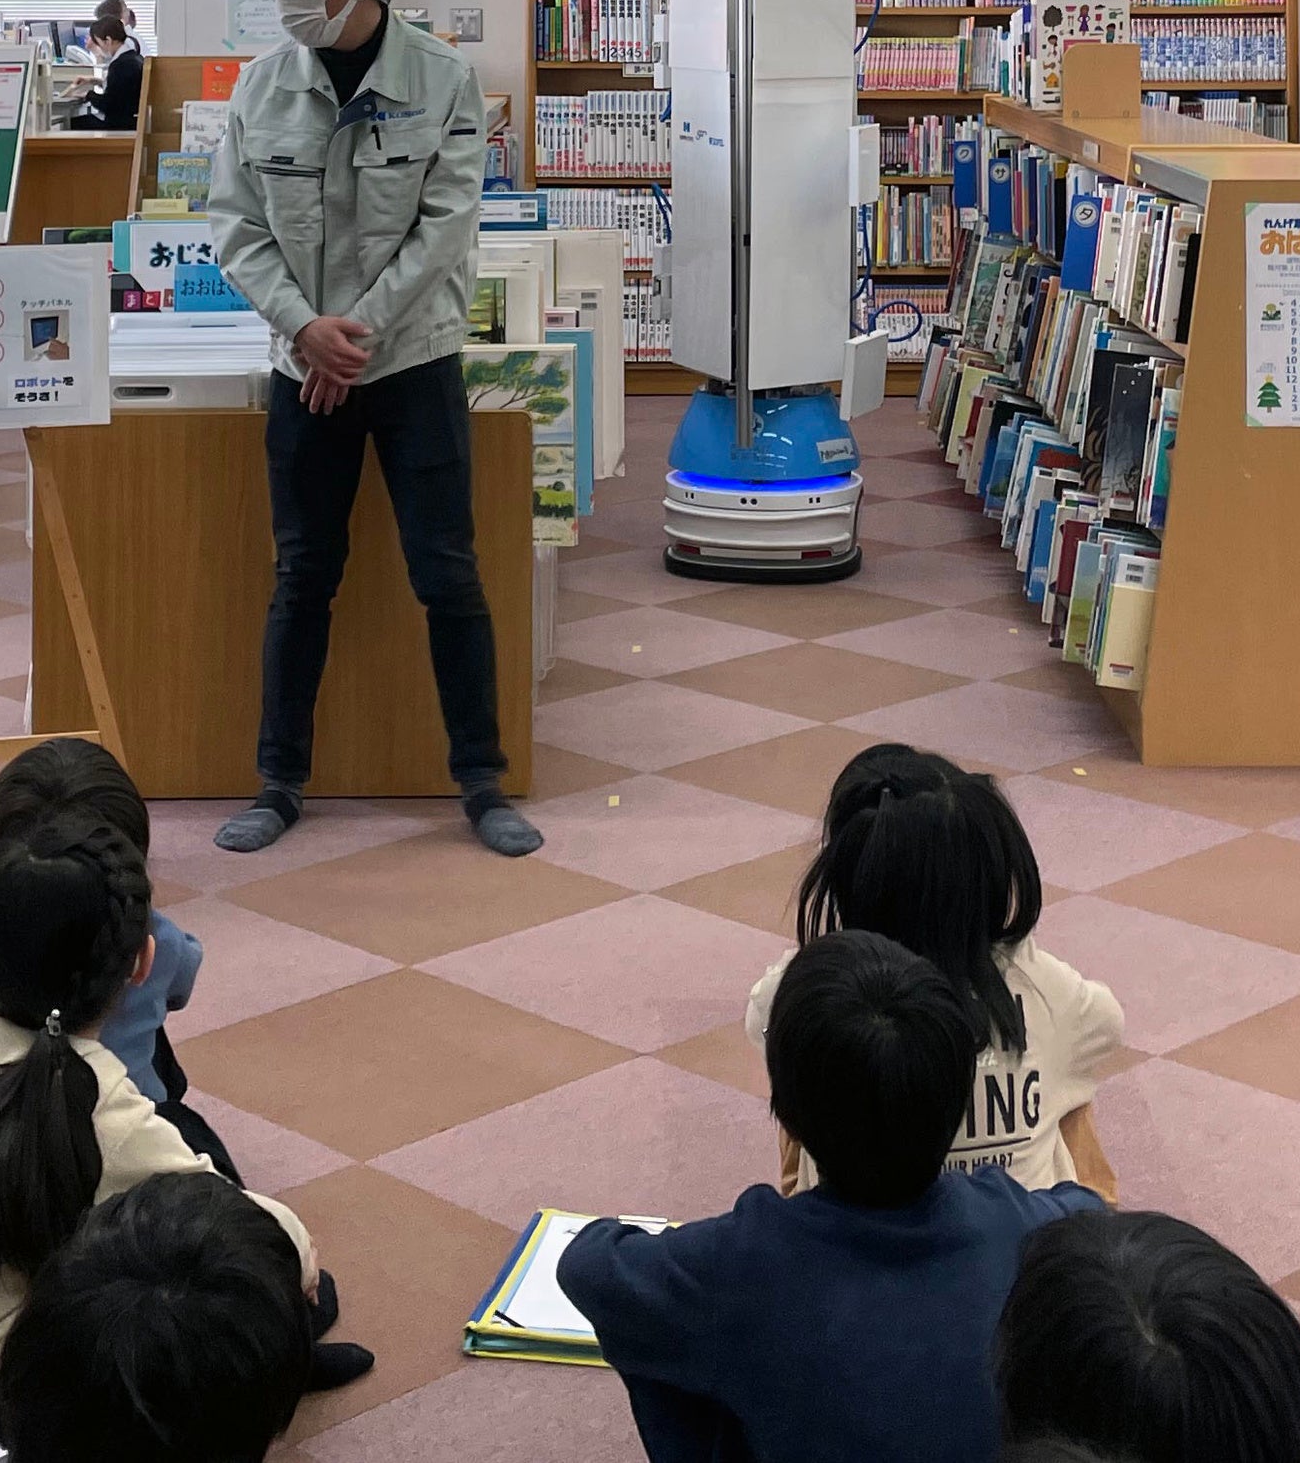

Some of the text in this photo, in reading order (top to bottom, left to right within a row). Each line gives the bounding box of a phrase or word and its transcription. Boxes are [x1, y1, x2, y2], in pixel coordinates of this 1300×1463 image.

[601, 47, 607, 58] 1
[611, 47, 616, 58] 2
[619, 47, 625, 58] 3
[627, 47, 633, 58] 4
[635, 47, 641, 58] 5
[995, 168, 1006, 179] サ
[1079, 208, 1093, 221] タ
[150, 242, 218, 267] おじさ
[21, 299, 73, 308] タッチパネル
[14, 376, 74, 387] ロボットを
[14, 391, 59, 403] そうさ！
[966, 1070, 1041, 1139] ING
